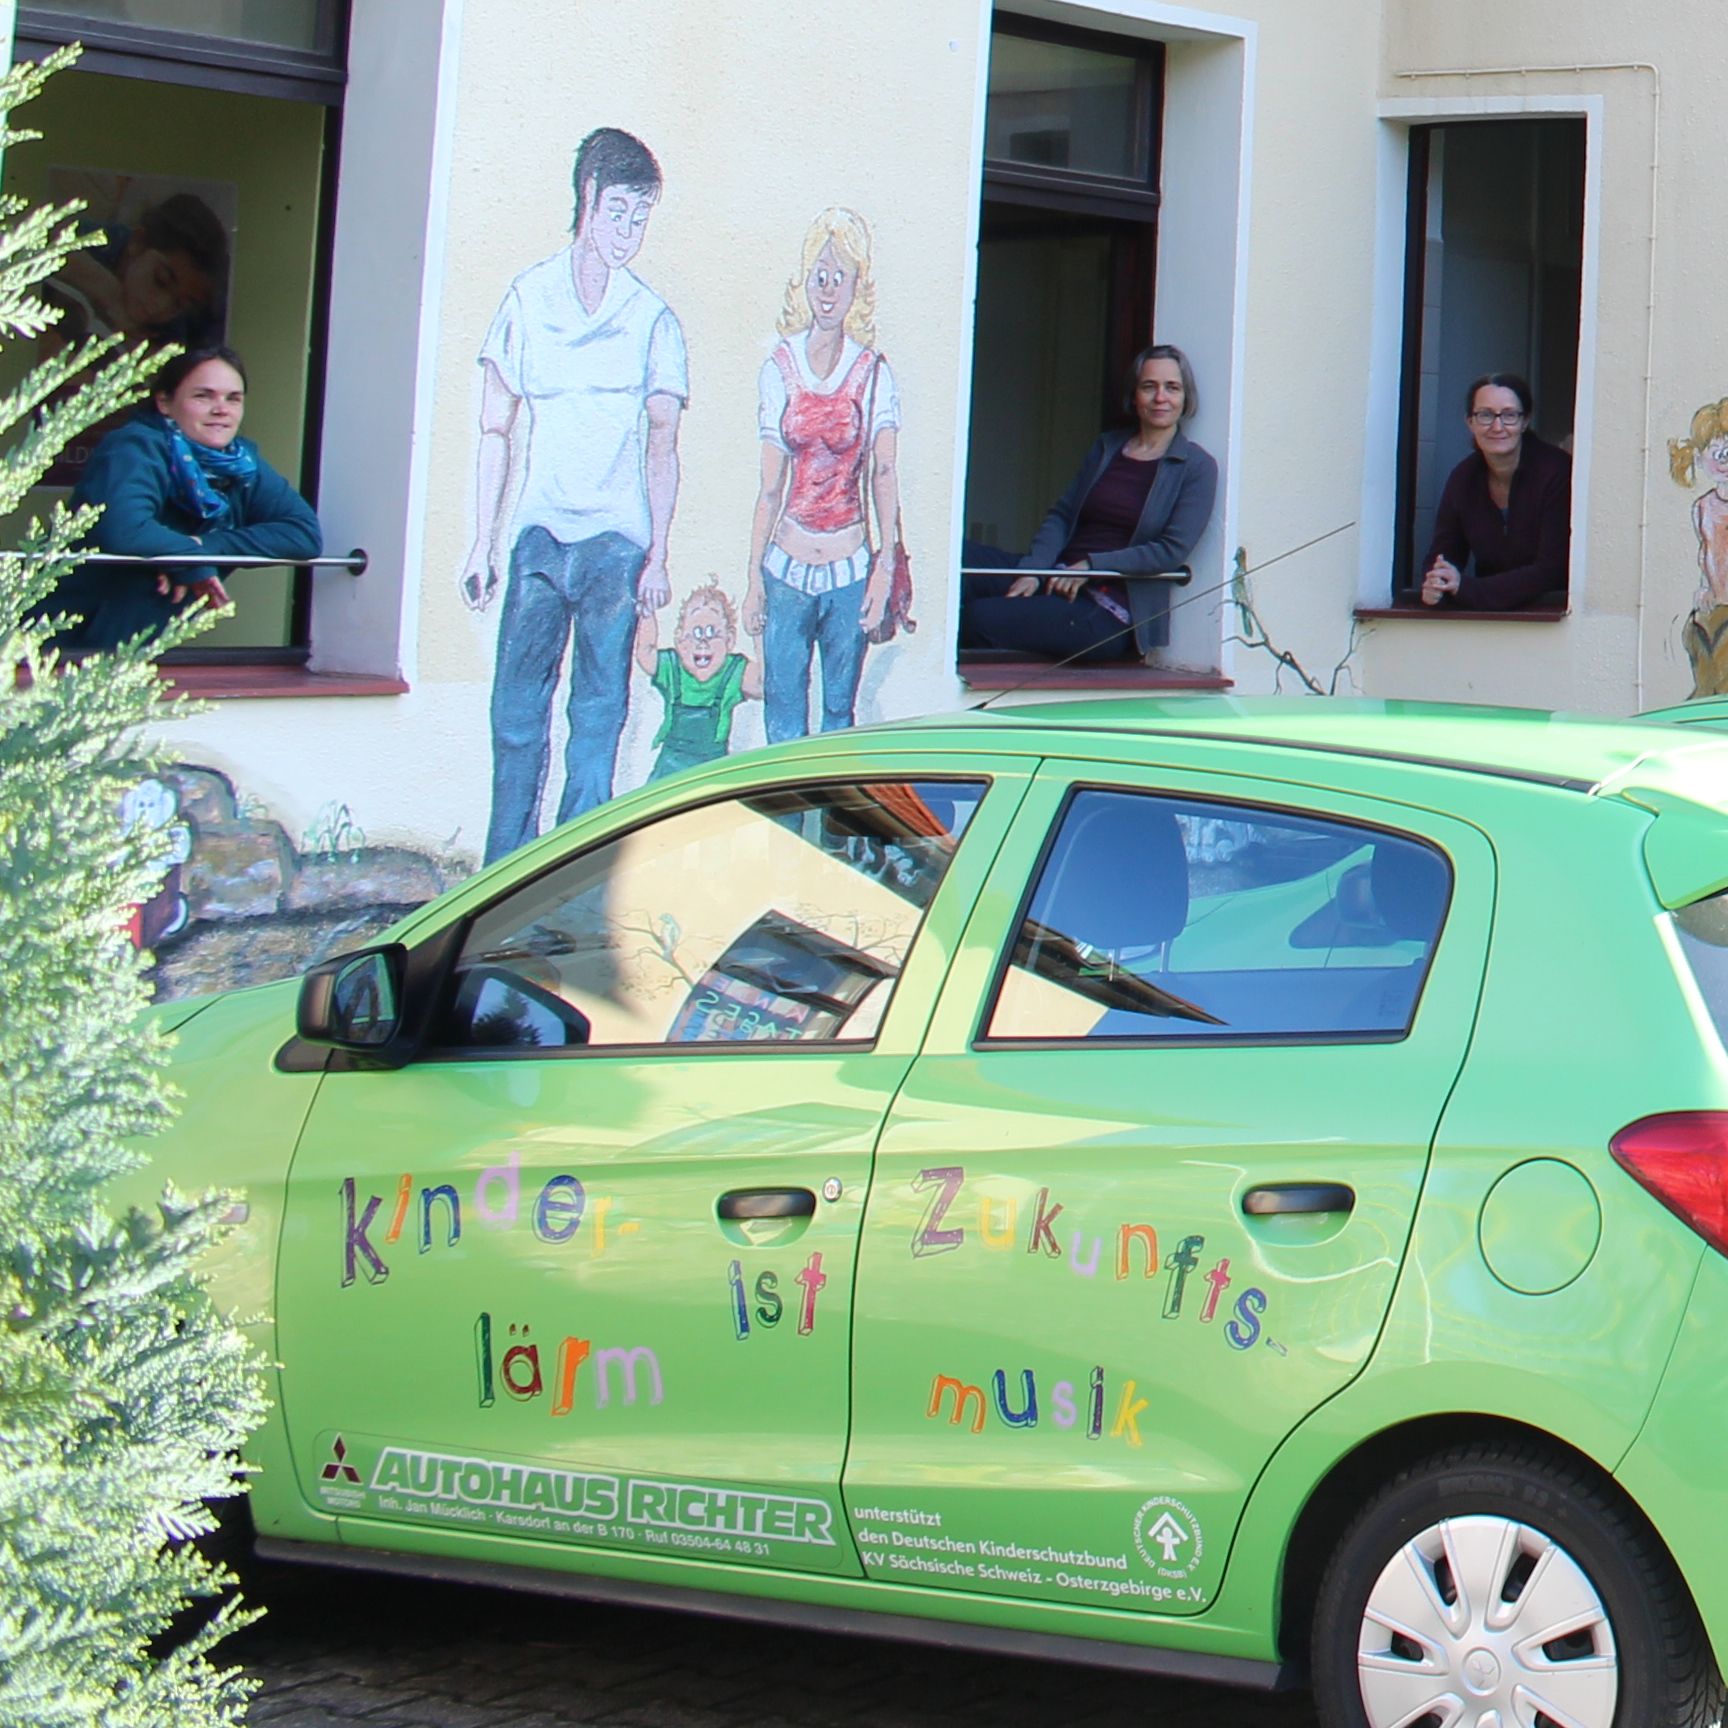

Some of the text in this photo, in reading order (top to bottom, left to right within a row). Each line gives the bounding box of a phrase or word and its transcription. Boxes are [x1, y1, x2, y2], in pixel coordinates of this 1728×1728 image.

[727, 1250, 828, 1341] ist
[473, 1311, 665, 1417] lärm
[924, 1364, 1150, 1447] musik
[369, 1445, 837, 1546] AUTOHAUS RICHTER
[378, 1494, 771, 1557] Inh. Jan Mücklich Karsdorf an der B 170 Ruf 03504-64 48 31
[854, 1506, 942, 1528] unterstützt
[858, 1528, 1128, 1571] den Deutschen Kinderschutzbund
[862, 1551, 885, 1567] KV
[888, 1553, 975, 1578] Sächsische
[977, 1562, 1043, 1585] Schweiz
[1056, 1572, 1173, 1602] Osterzgebirge
[1176, 1585, 1208, 1604] e.V.
